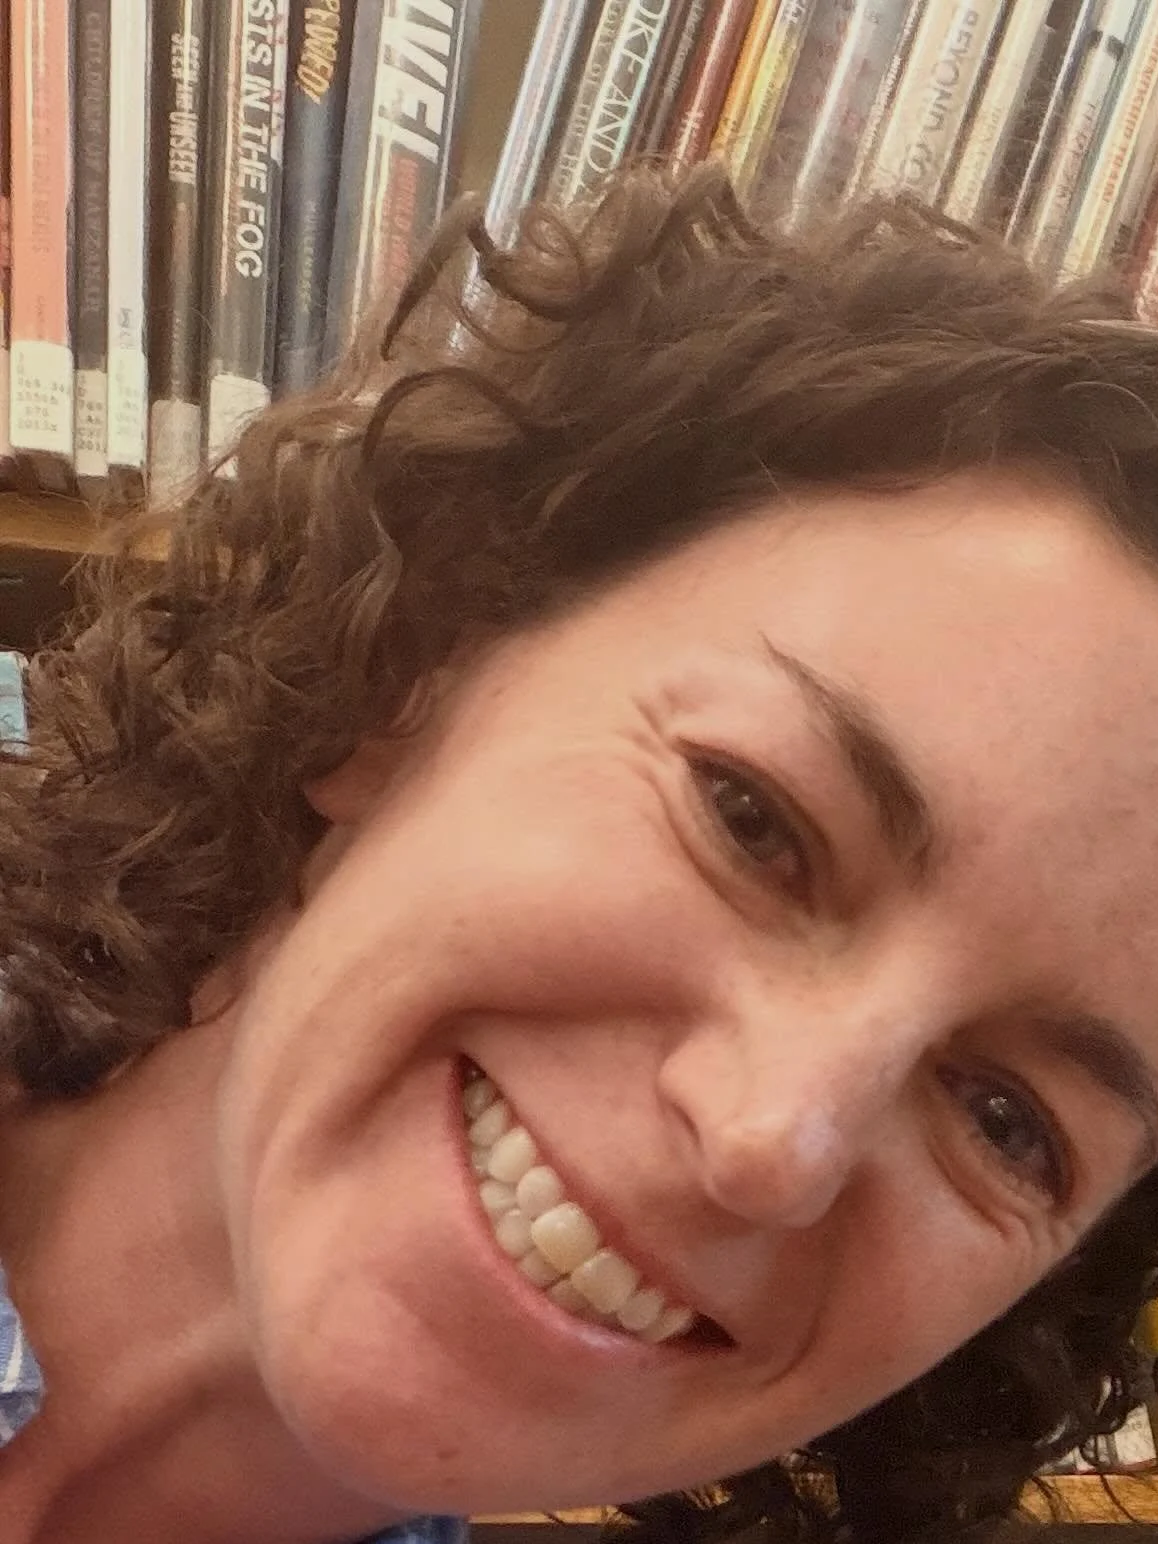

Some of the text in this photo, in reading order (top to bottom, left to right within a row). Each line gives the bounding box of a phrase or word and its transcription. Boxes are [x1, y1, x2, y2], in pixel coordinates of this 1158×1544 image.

[244, 75, 273, 110] IN
[167, 111, 197, 184] UNSEEN
[239, 121, 270, 193] THE
[587, 86, 634, 175] AND
[234, 200, 266, 279] FOG
